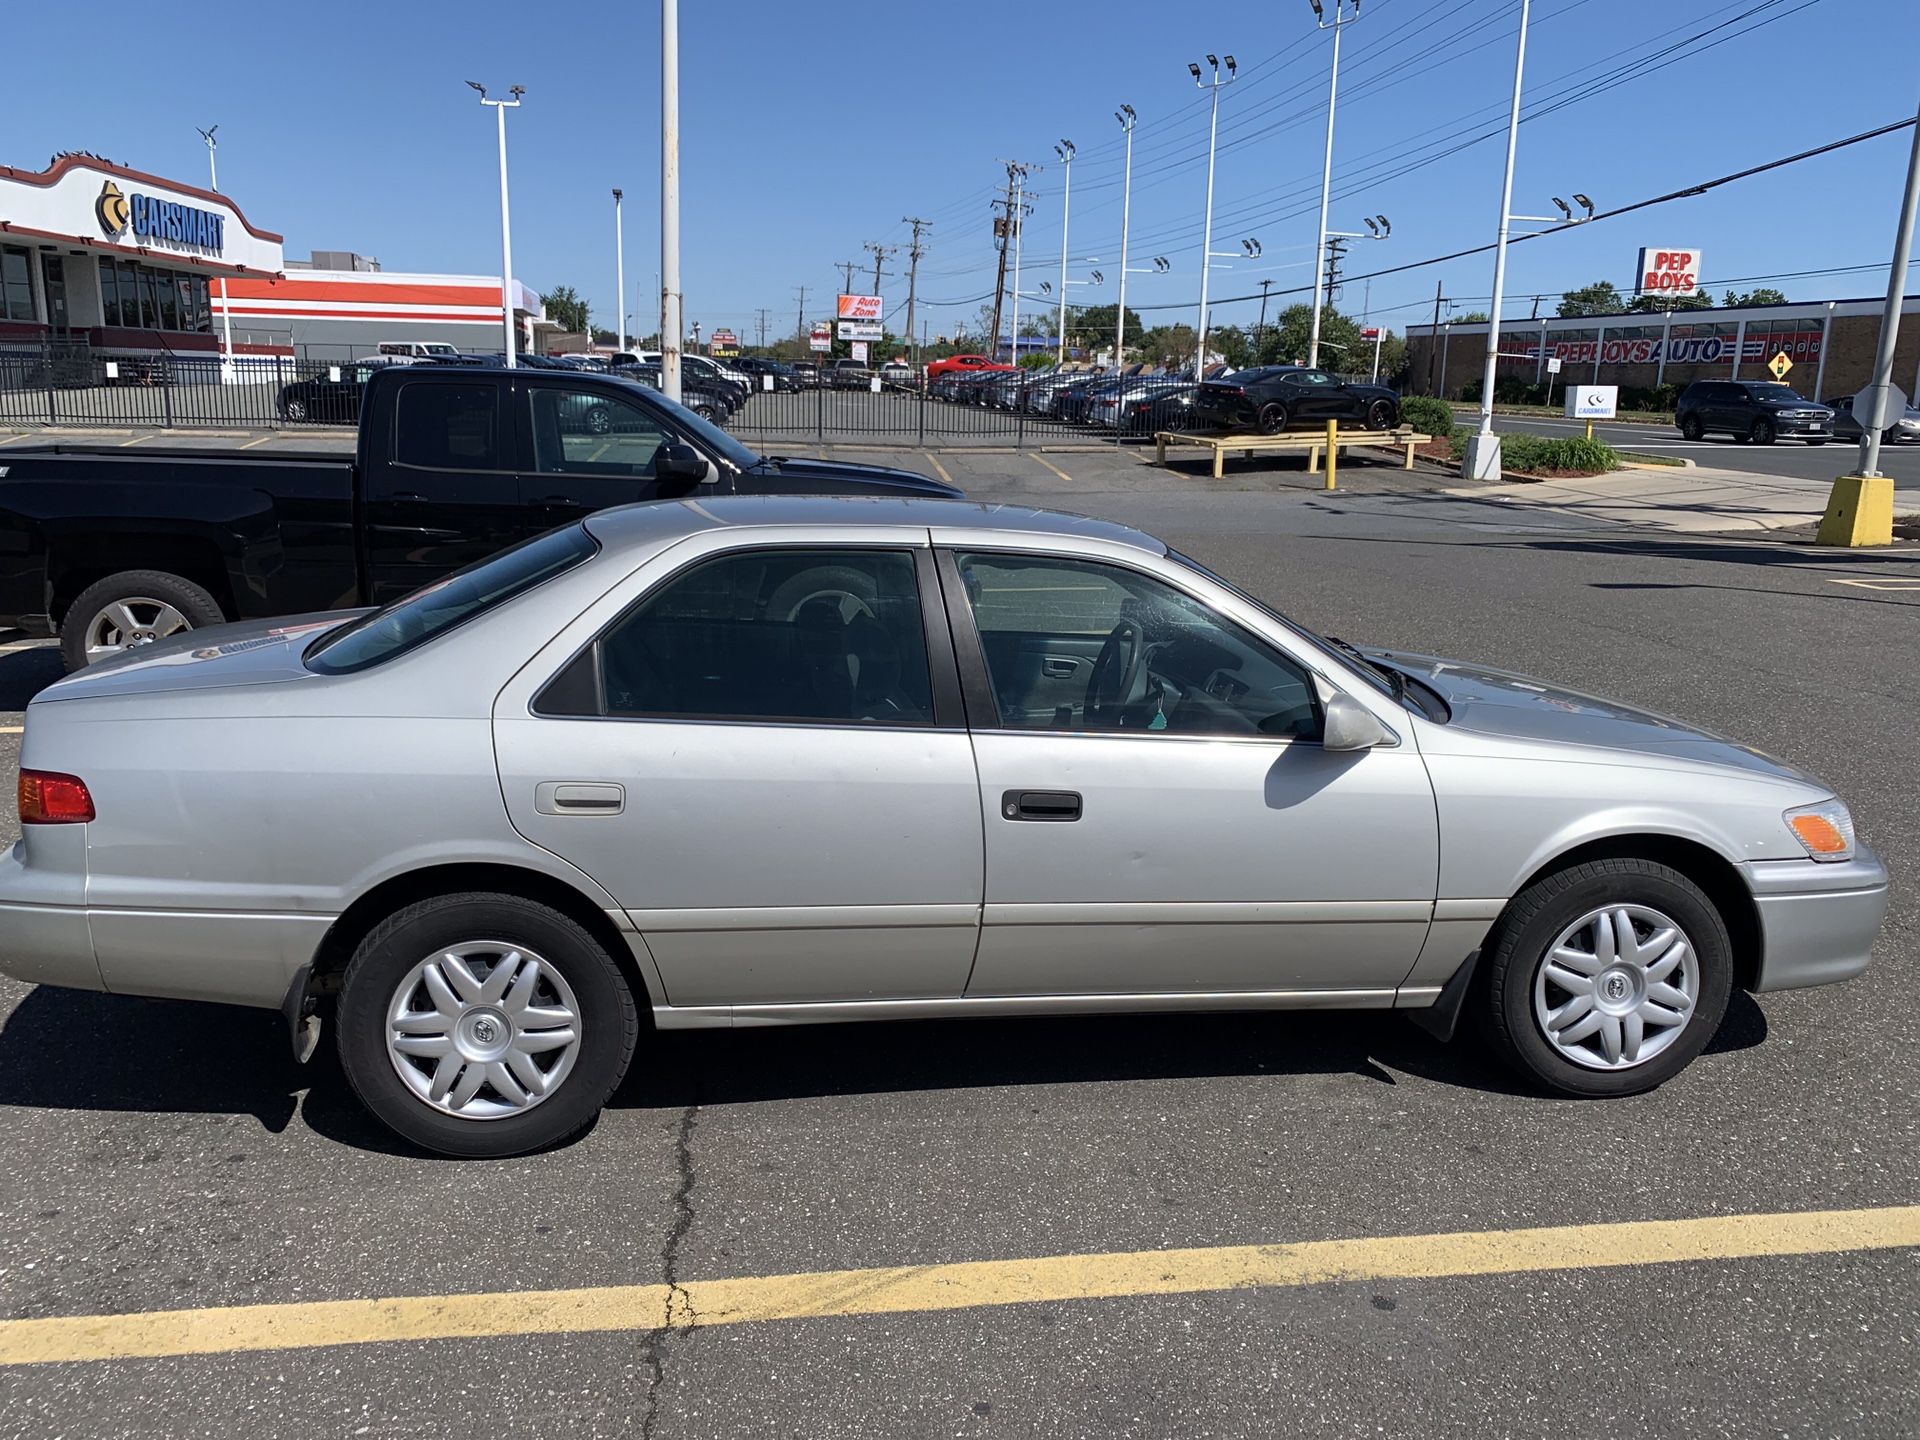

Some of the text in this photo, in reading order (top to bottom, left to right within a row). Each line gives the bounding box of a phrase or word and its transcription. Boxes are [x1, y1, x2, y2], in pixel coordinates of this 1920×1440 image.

[130, 193, 225, 251] CARSMART
[1655, 252, 1692, 271] PEP
[1645, 271, 1695, 292] BOYS
[857, 297, 880, 306] Auto
[852, 307, 877, 317] Zone
[1578, 407, 1611, 415] CARSMART
